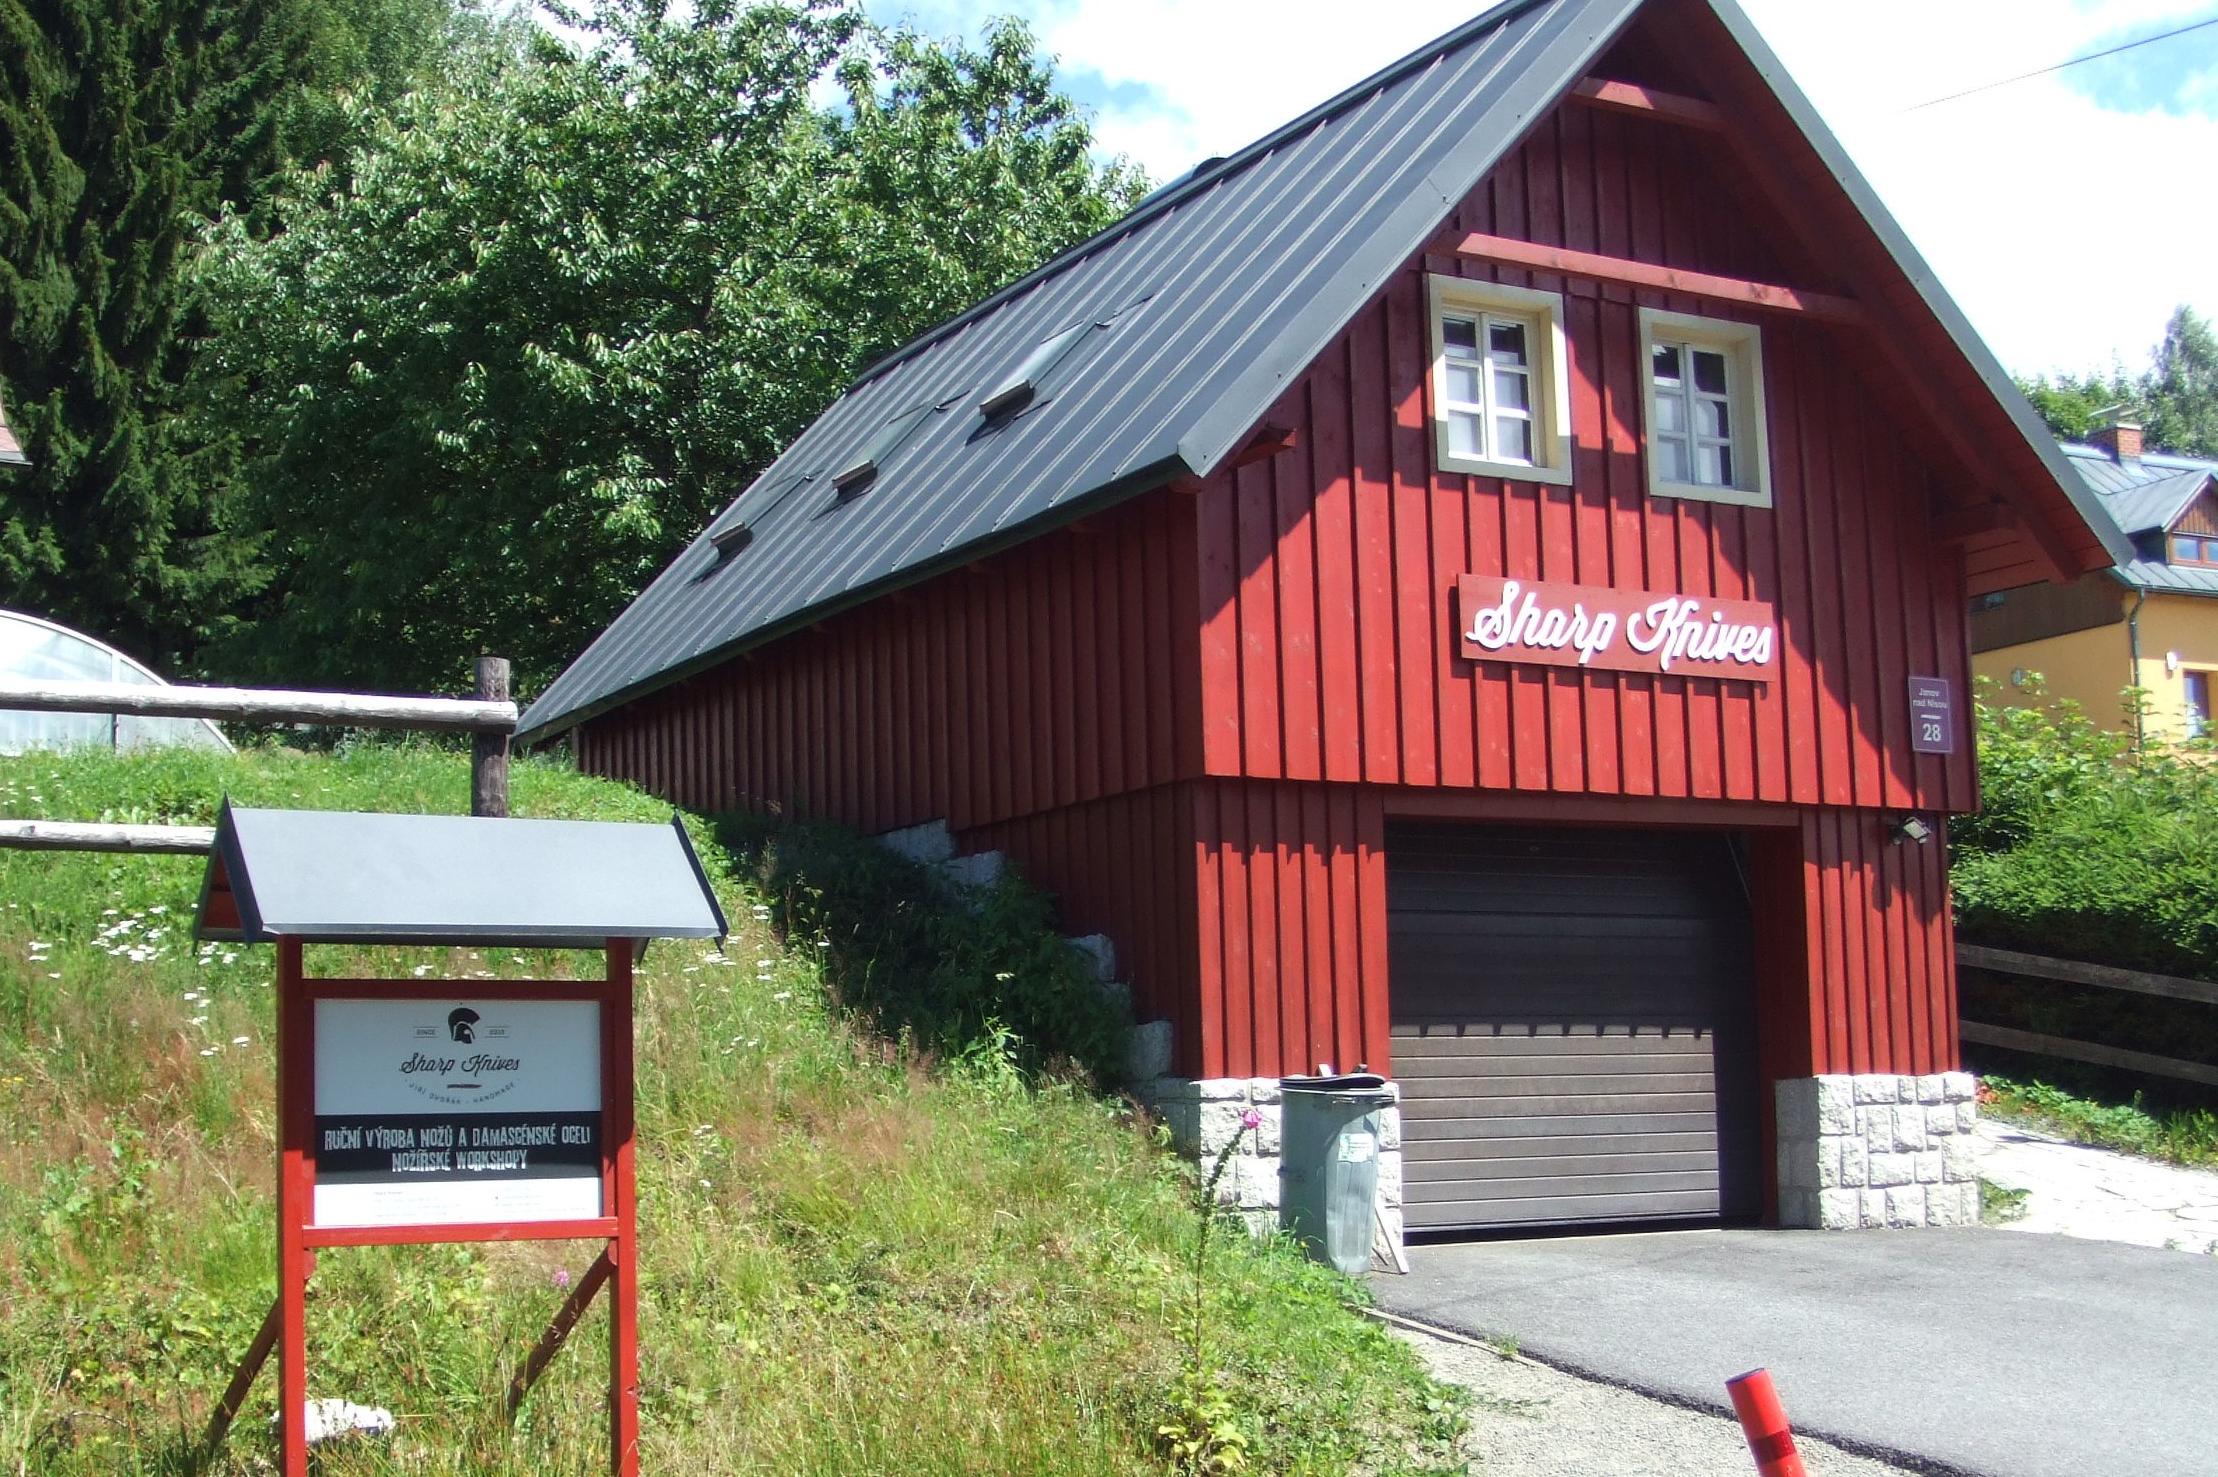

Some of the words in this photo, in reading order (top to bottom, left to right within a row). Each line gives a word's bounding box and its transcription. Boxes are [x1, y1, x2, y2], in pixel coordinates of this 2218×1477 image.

[1465, 580, 1617, 664] Sharp
[1626, 597, 1773, 672] Knives
[1922, 723, 1942, 742] 28
[399, 1052, 455, 1076] Sharp
[461, 1053, 521, 1078] Knives
[324, 1126, 362, 1150] RUČNÍ
[366, 1125, 414, 1149] VÝROBA
[420, 1125, 453, 1147] NOŽŮ
[458, 1127, 467, 1147] A
[473, 1123, 557, 1147] DAMASCÉNSKÉ
[562, 1125, 591, 1145] OCELI
[392, 1149, 451, 1172] NOŽÍŘSKÉ
[456, 1149, 528, 1171] WORKSHOPY
